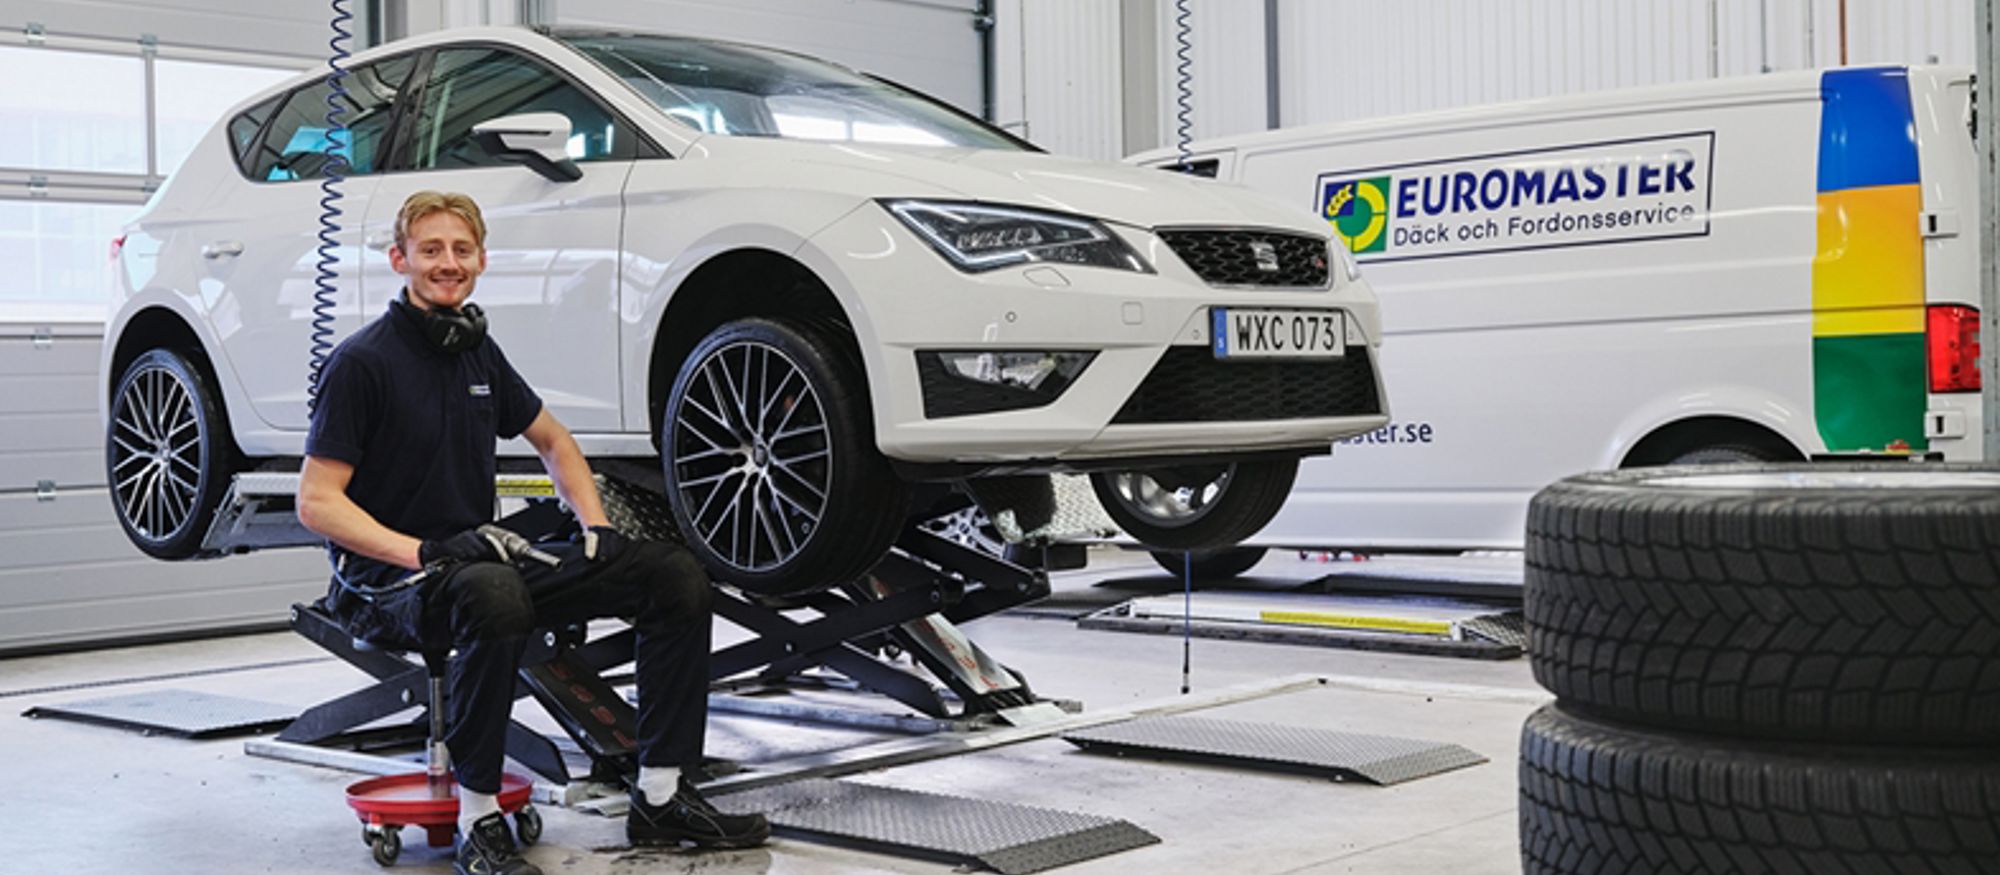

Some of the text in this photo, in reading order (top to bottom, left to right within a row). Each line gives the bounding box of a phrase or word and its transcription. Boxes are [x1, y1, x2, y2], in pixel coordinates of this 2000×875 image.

[1397, 150, 1695, 218] EUROMASTER
[1394, 202, 1695, 247] Däck och Fordonsservice
[1236, 315, 1335, 350] WXC 073
